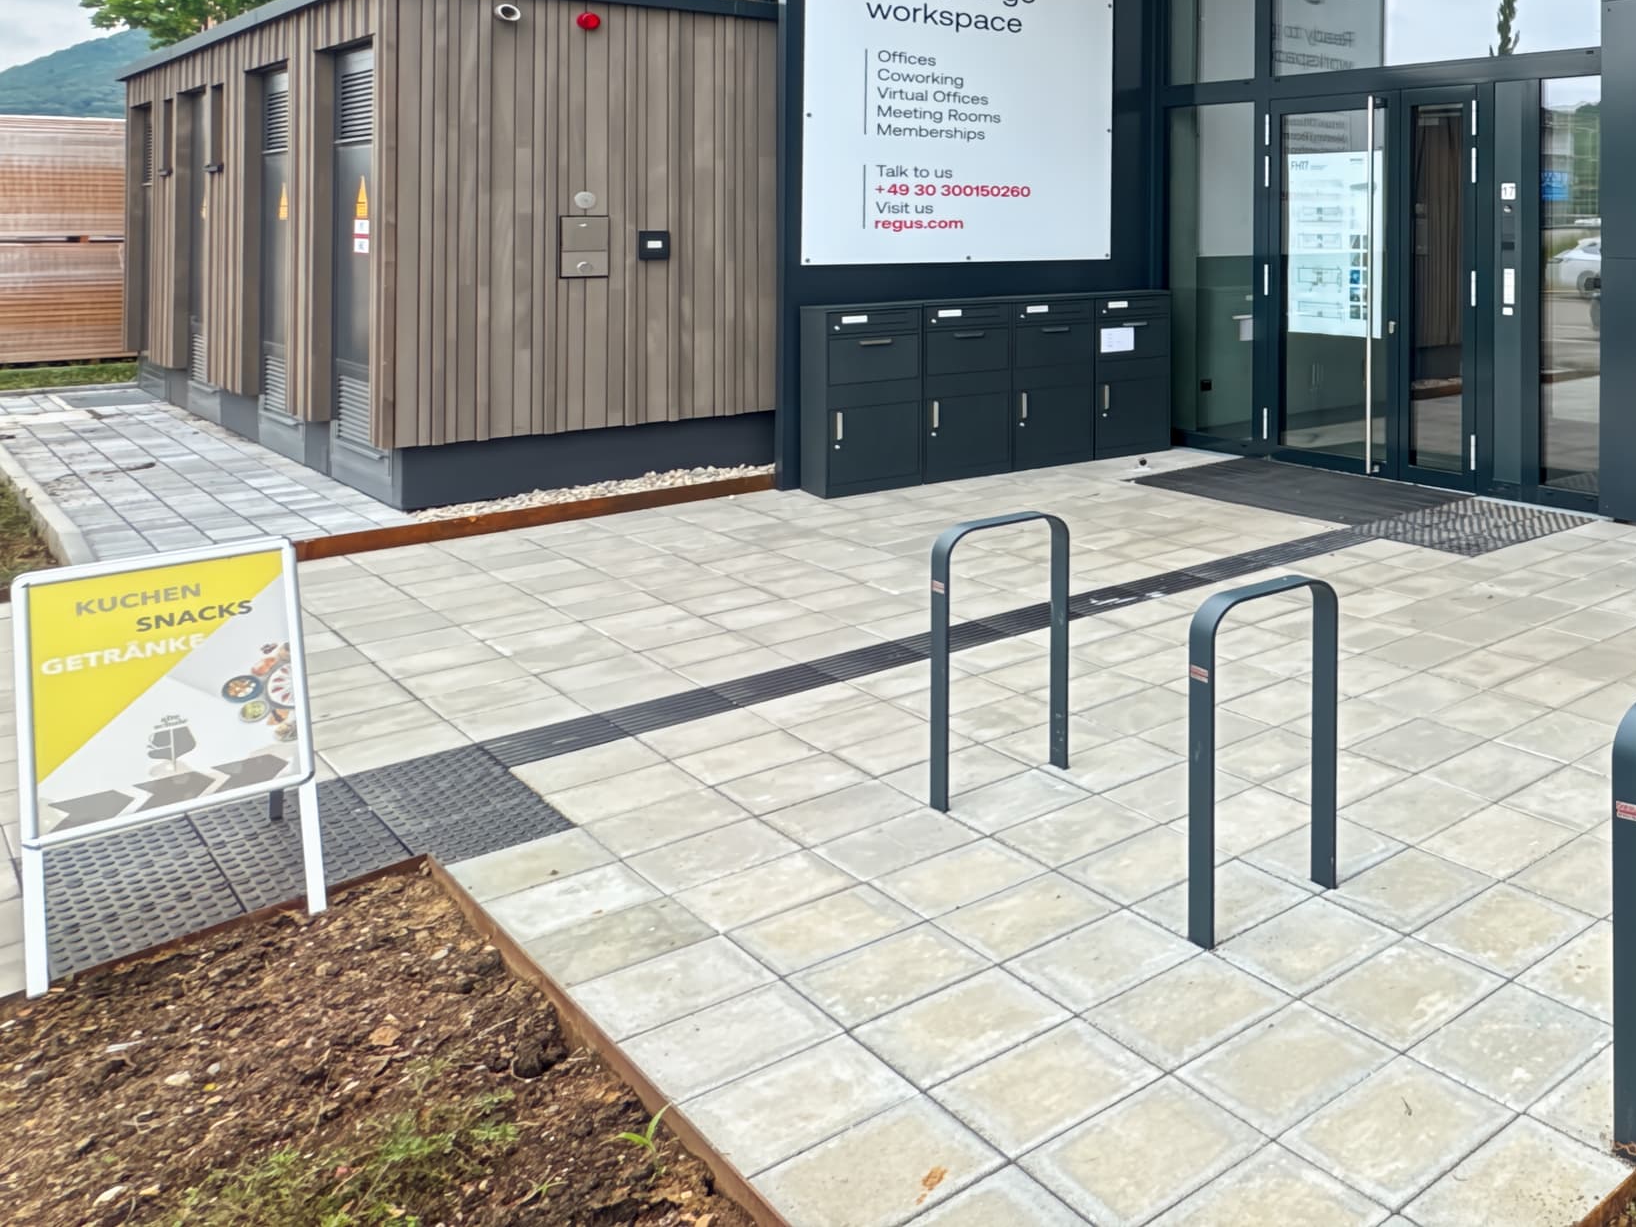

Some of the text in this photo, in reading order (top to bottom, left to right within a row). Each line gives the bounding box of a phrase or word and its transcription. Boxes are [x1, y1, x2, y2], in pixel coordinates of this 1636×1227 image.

[866, 2, 1022, 33] workspace
[878, 49, 937, 66] Offices
[877, 68, 964, 89] Coworking
[877, 86, 989, 106] Virtual Offices
[877, 105, 1001, 124] Meeting Rooms
[877, 123, 985, 143] Memberships
[876, 164, 953, 179] Talk to us
[875, 183, 1031, 198] +49 30 300150260
[1503, 186, 1515, 198] 17
[876, 201, 934, 214] Visit us
[874, 219, 964, 233] regus.com
[76, 583, 201, 616] KUCHEN
[136, 600, 253, 632] SNACKS
[41, 633, 205, 675] GETRÄNKE
